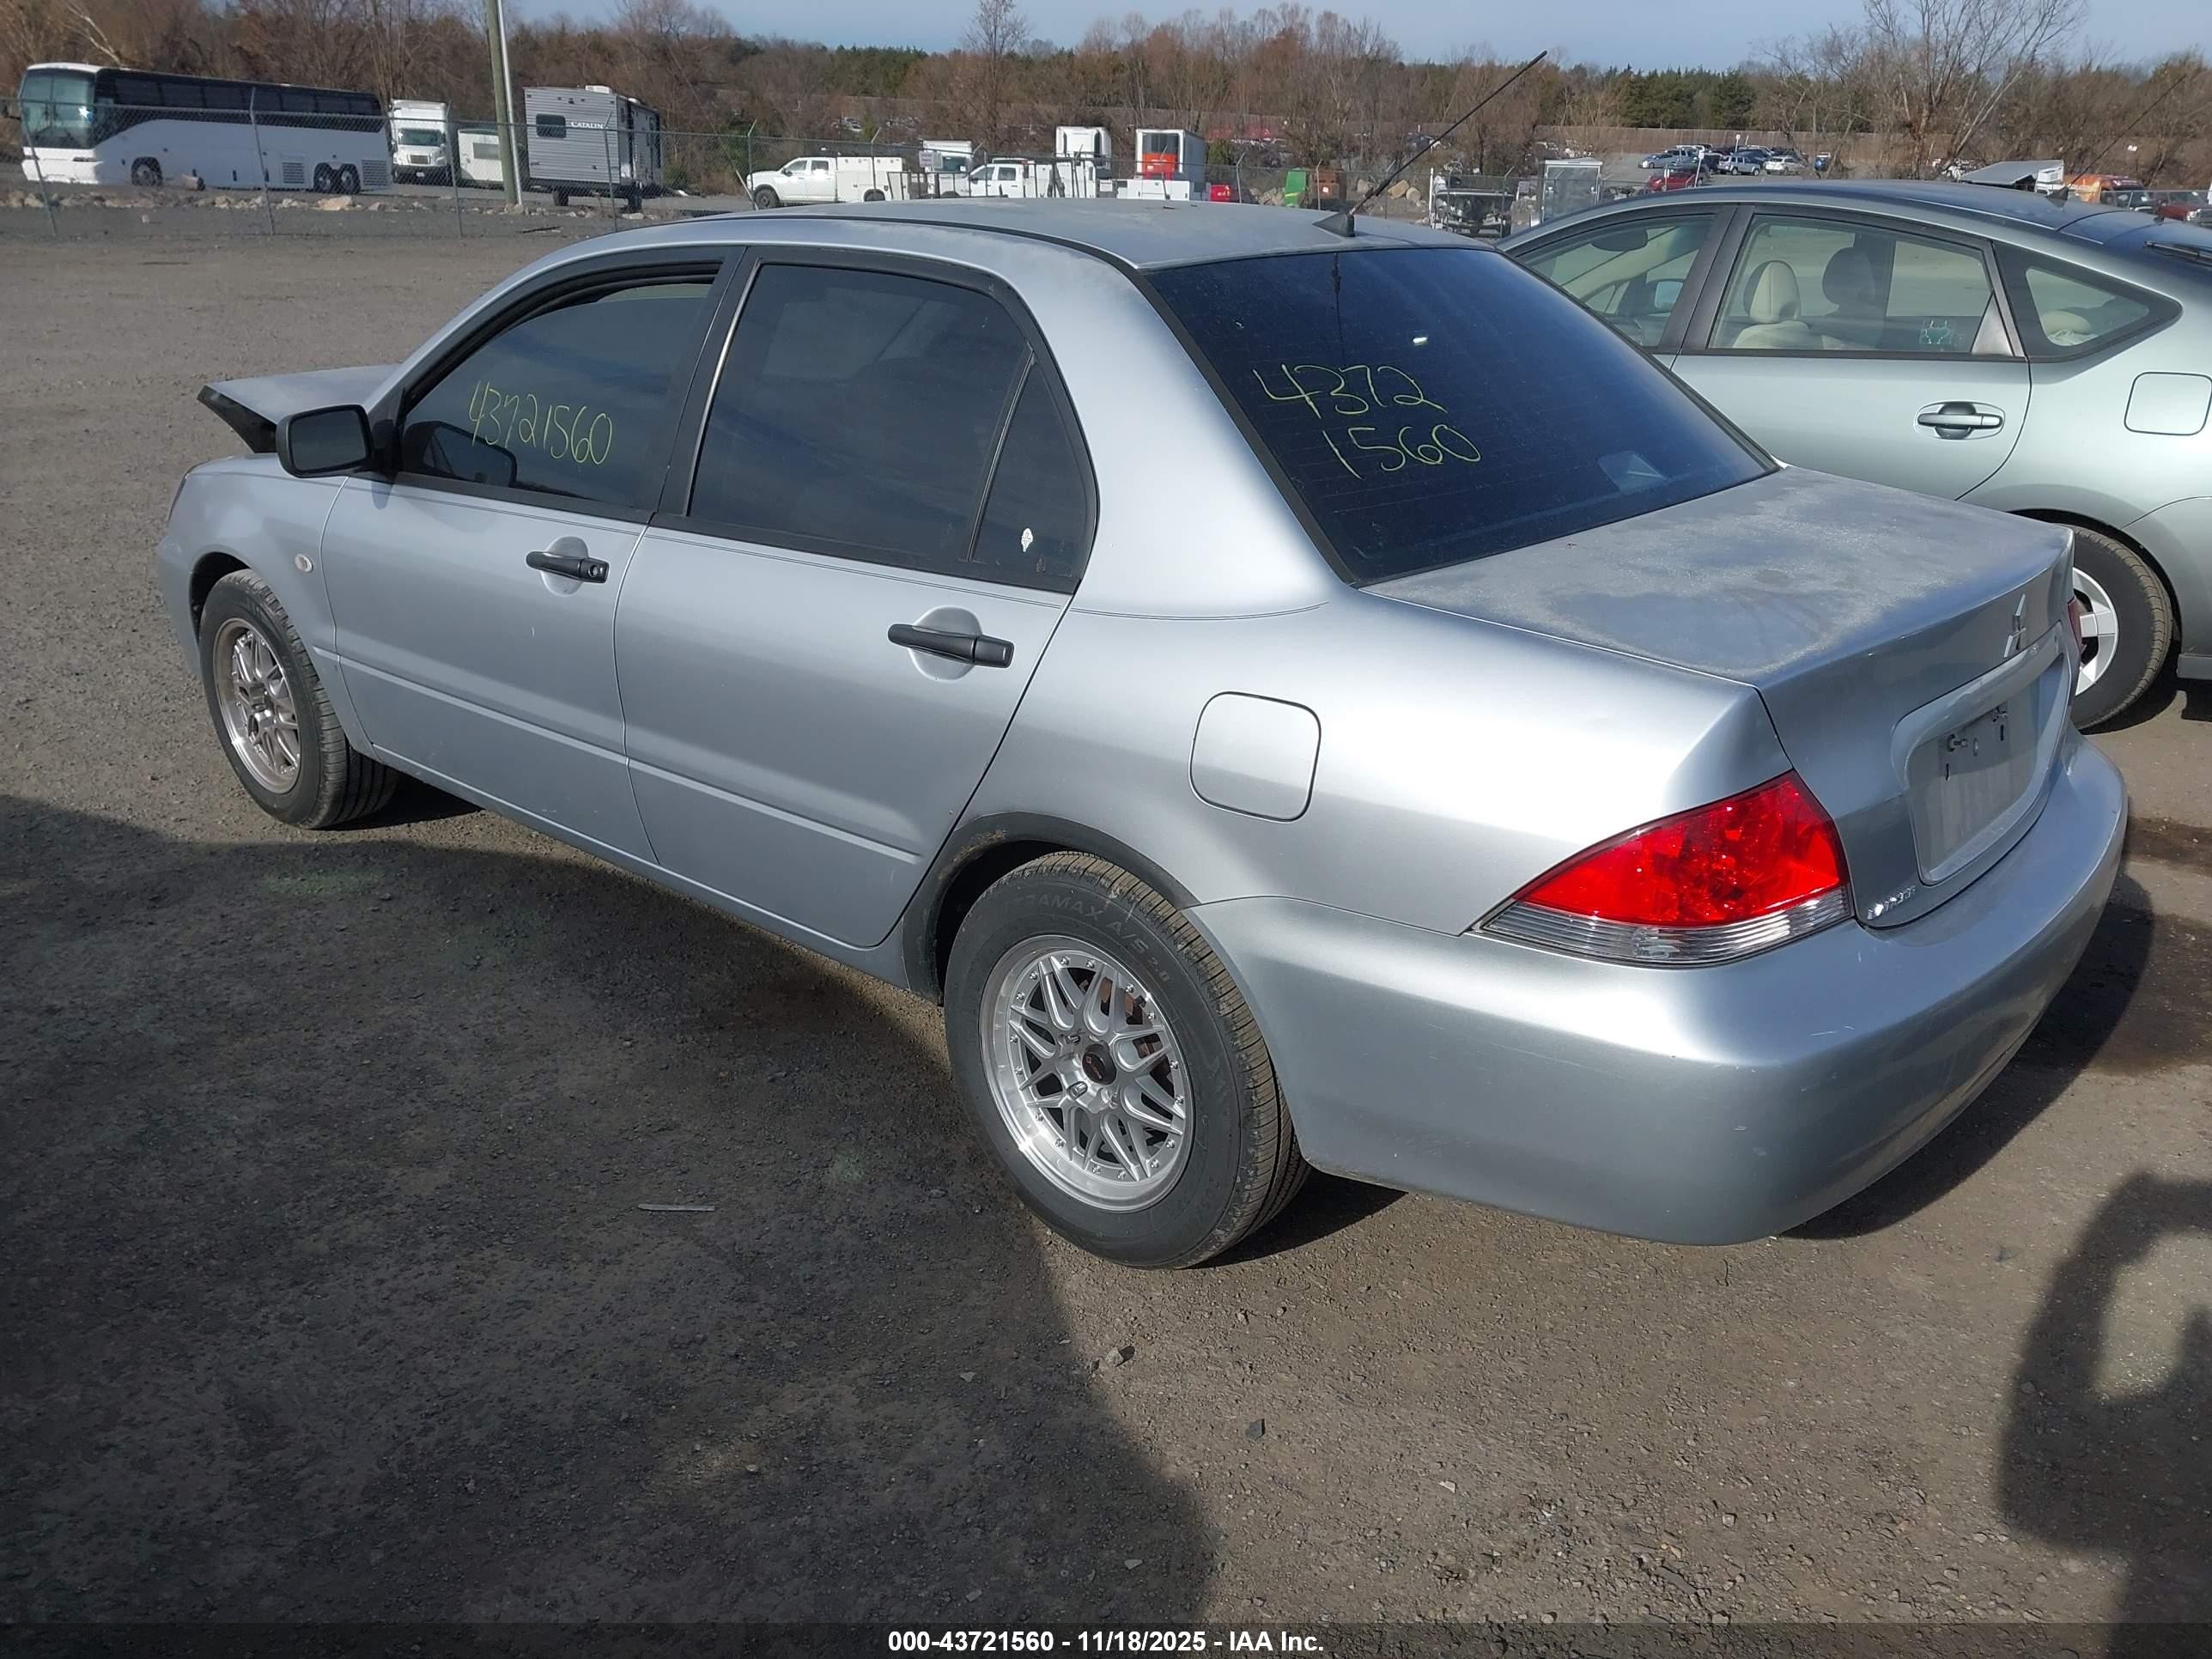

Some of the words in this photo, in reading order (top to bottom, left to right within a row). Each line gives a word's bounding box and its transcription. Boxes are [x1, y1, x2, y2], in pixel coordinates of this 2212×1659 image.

[570, 121, 609, 130] CATALIN
[1252, 363, 1449, 420] 4372
[469, 379, 613, 465] 43721560
[1322, 424, 1481, 480] 1560
